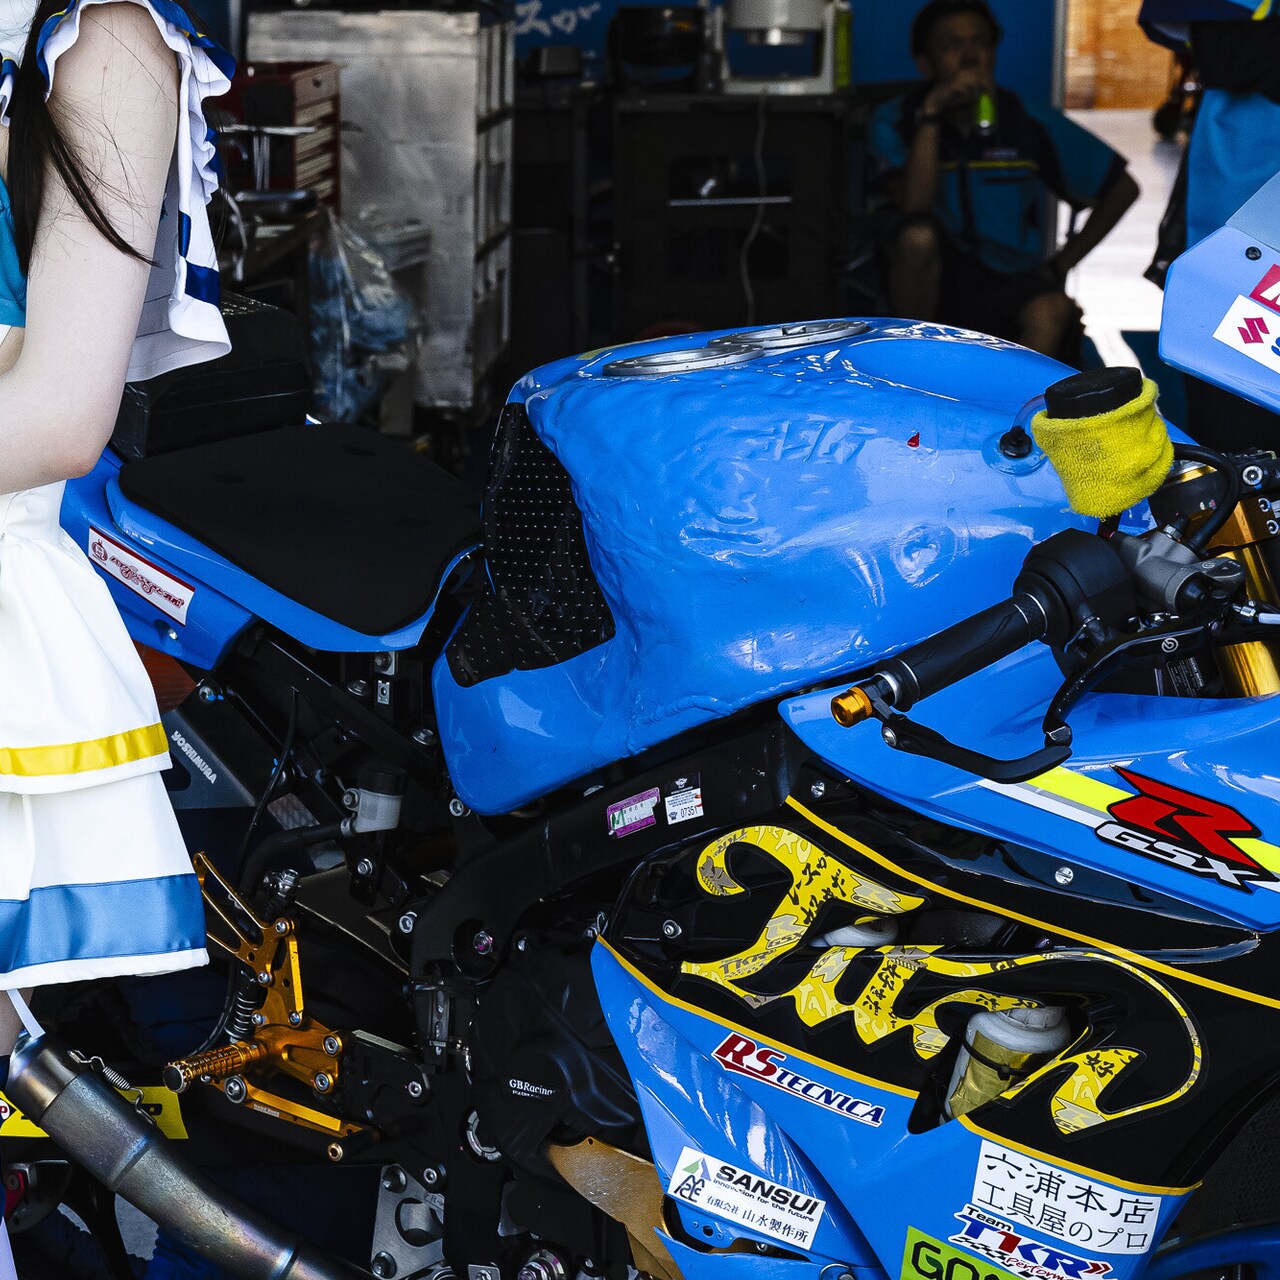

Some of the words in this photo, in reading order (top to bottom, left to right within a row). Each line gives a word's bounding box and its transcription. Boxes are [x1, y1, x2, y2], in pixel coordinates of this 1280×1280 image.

[170, 730, 218, 785] YOSHIMURA
[680, 805, 699, 818] 07351
[775, 1067, 886, 1125] TECNICA
[717, 1165, 819, 1215] SANSUI
[757, 1196, 770, 1205] for
[771, 1203, 786, 1212] the
[787, 1208, 815, 1223] future
[984, 1152, 1156, 1225] 六浦本店
[707, 1195, 739, 1215] 有限会社
[741, 1209, 810, 1243] 山水製作所
[966, 1206, 1013, 1232] Team
[977, 1180, 1150, 1251] 工具屋のプロ
